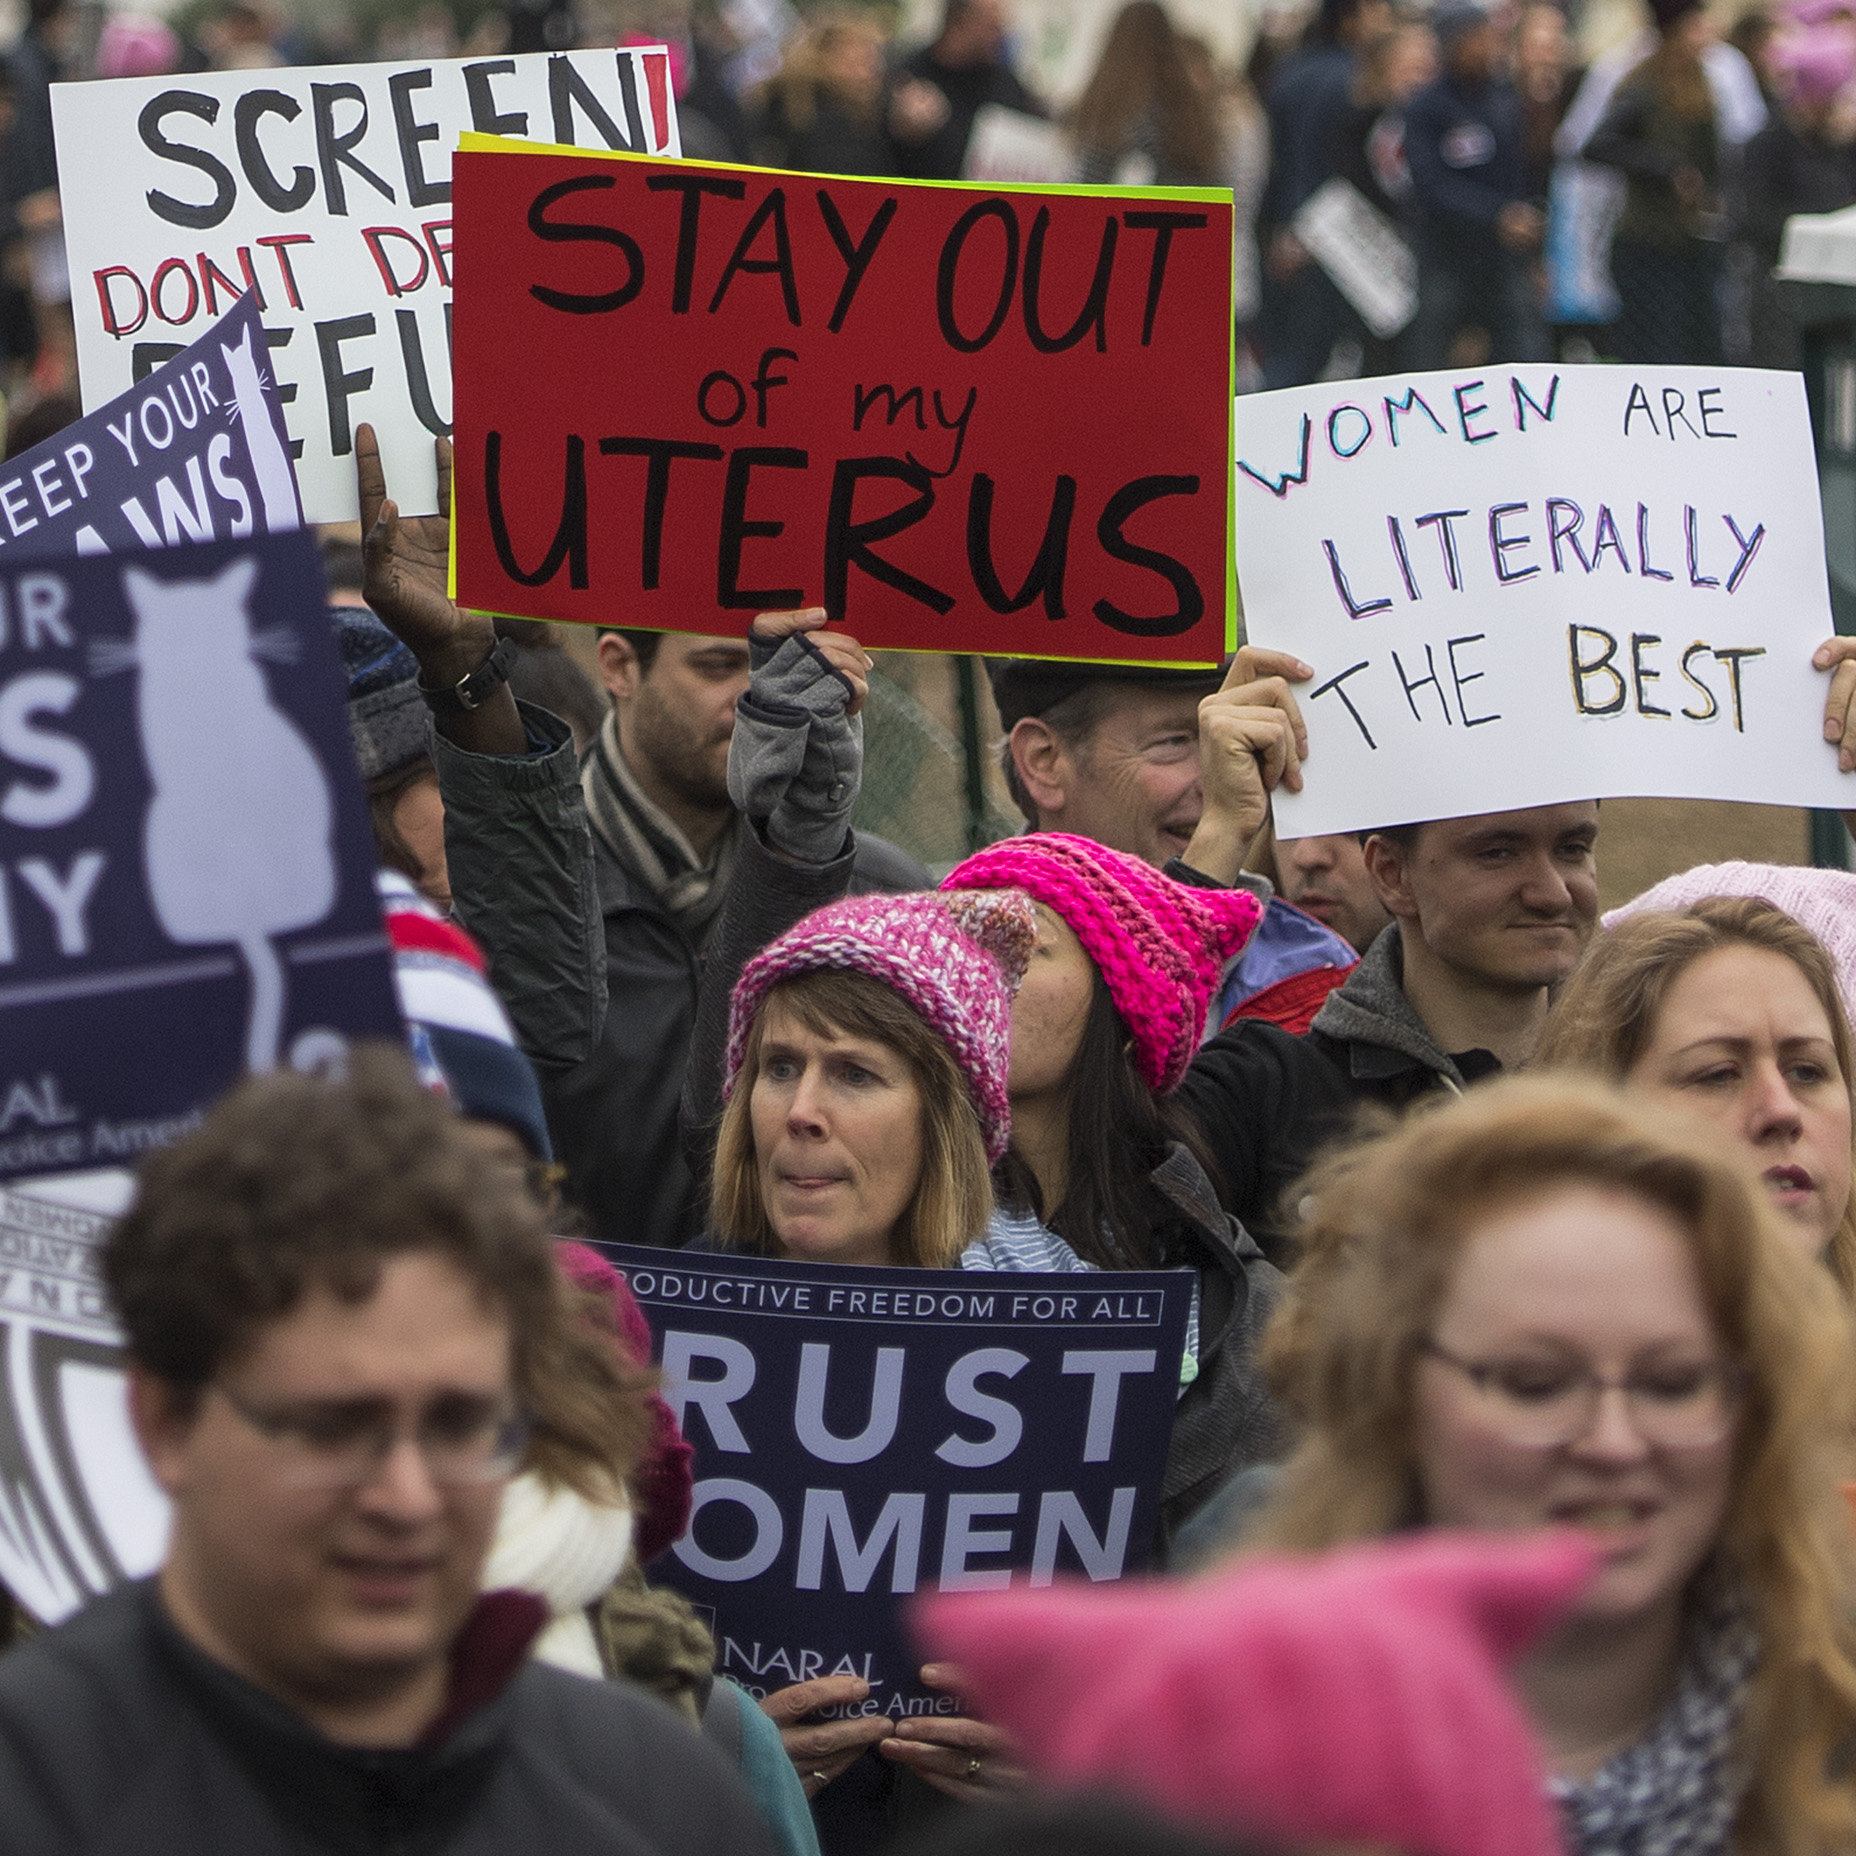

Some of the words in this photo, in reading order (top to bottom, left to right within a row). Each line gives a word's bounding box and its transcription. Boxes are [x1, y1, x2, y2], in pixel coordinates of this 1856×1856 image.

[93, 233, 314, 340] DONT
[527, 175, 898, 333] STAY
[936, 196, 1208, 354] OUT
[106, 361, 219, 467] YOUR
[697, 347, 798, 428] of
[852, 383, 977, 479] my
[1236, 374, 1561, 499] WOMEN
[1624, 382, 1738, 441] ARE
[484, 430, 1205, 639] UTERUS
[1321, 497, 1766, 620] LITERALLY
[1310, 633, 1502, 750] THE
[1568, 622, 1767, 734] BEST
[615, 1270, 811, 1310] ODUCTIVE
[828, 1290, 994, 1318] FREEDOM
[1012, 1296, 1079, 1319] FOR
[1091, 1296, 1151, 1319] ALL
[660, 1330, 1157, 1468] RUST
[670, 1477, 1136, 1593] OMEN
[723, 1636, 884, 1687] NARAL
